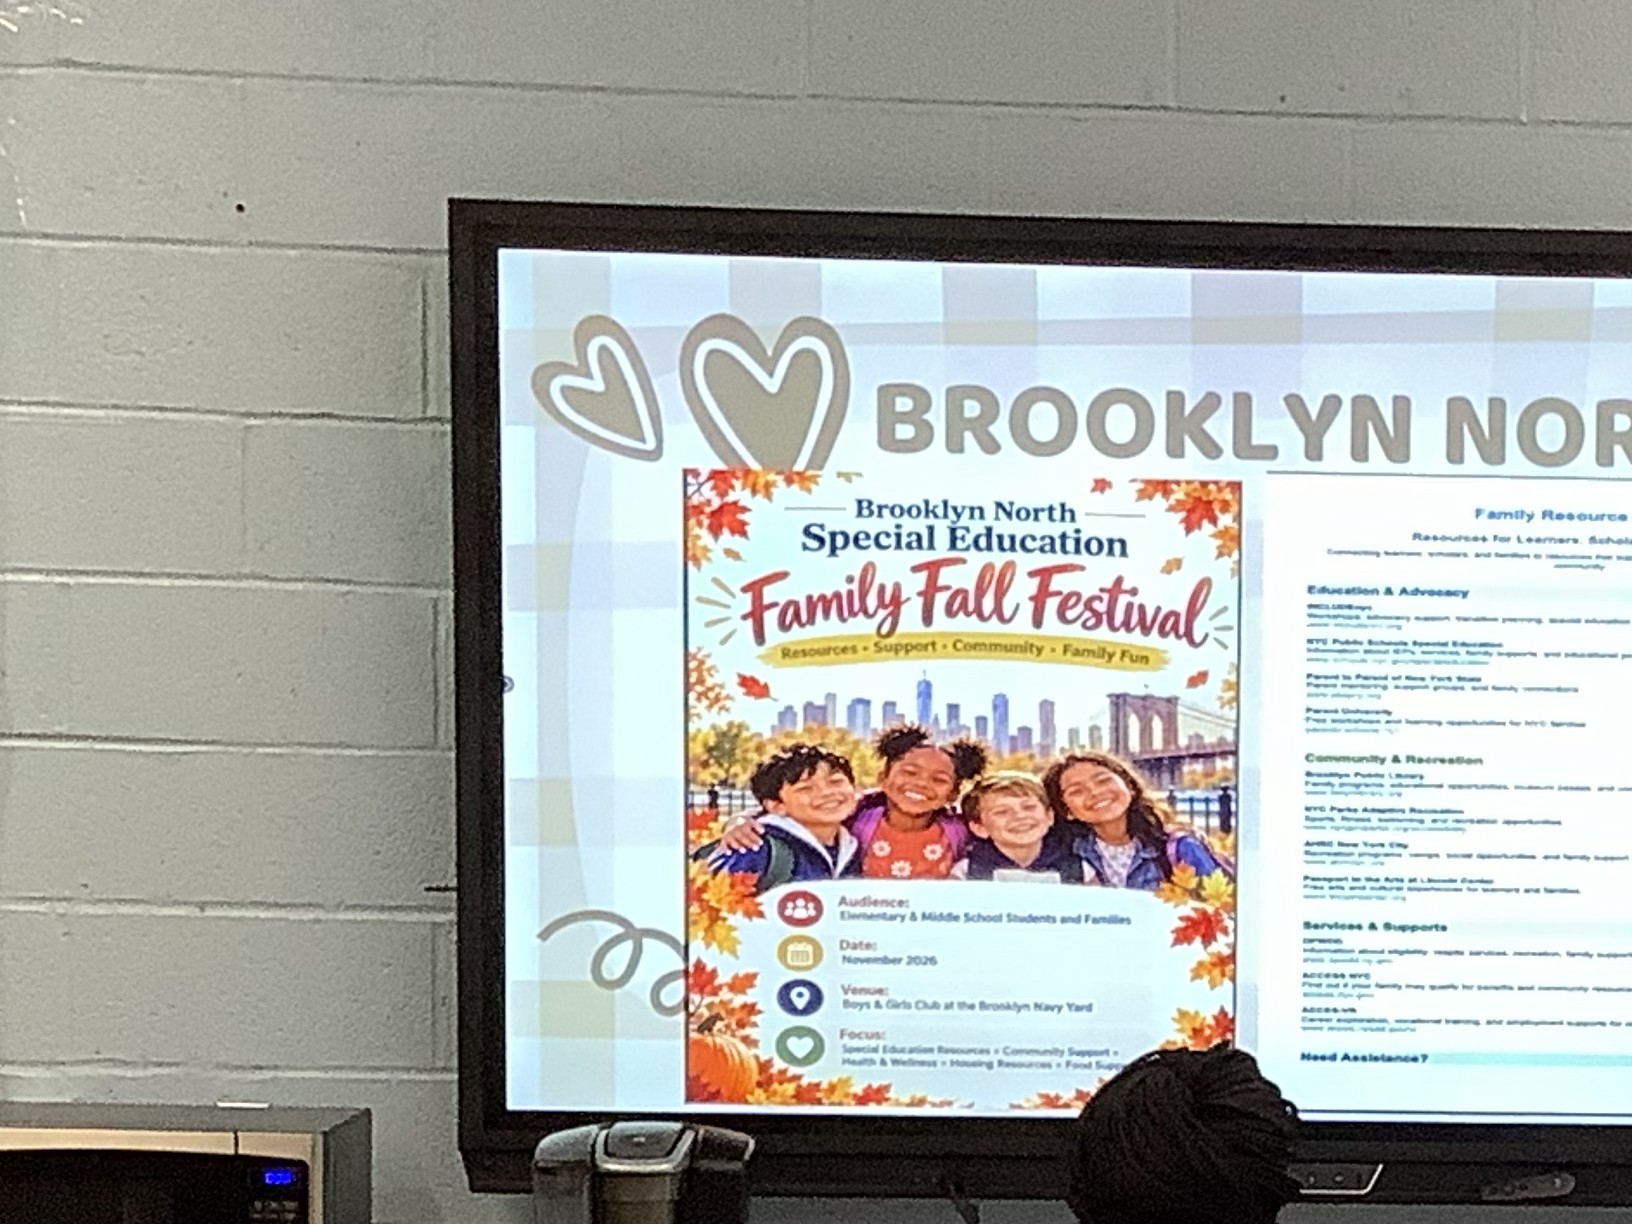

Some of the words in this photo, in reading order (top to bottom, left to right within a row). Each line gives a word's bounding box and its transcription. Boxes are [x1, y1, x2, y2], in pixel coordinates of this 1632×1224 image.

[877, 382, 1411, 464] BROOKLYN
[854, 499, 987, 525] Brooklyn
[993, 501, 1077, 524] North
[1475, 508, 1535, 523] Family
[1541, 510, 1628, 522] Resource
[801, 523, 936, 558] Special
[947, 525, 1129, 559] Education
[1307, 584, 1380, 596] Education
[1383, 585, 1394, 597] &
[1399, 587, 1469, 598] Advocacy
[739, 560, 909, 646] Family
[909, 557, 1020, 628] Fall
[1027, 562, 1214, 649] Festival
[781, 643, 858, 661] Resources
[873, 640, 937, 656] Support
[952, 639, 1044, 658] Community
[1062, 644, 1116, 664] Family
[1119, 648, 1150, 666] Fun
[1305, 753, 1386, 764] Community
[1391, 753, 1401, 765] &
[1405, 755, 1483, 765] Recreation
[838, 895, 910, 909] Audience:
[840, 911, 907, 923] Elementary
[909, 911, 918, 922] &
[921, 912, 961, 922] Middle
[964, 912, 1003, 923] School
[1006, 912, 1057, 924] Students
[1060, 913, 1082, 924] and
[1085, 914, 1132, 925] Families
[1303, 920, 1363, 931] Services
[1368, 920, 1378, 932] &
[1383, 922, 1447, 933] Supports
[839, 939, 877, 951] Date:
[842, 955, 903, 965] November
[906, 955, 938, 966] 2026
[841, 984, 889, 996] Venue:
[843, 999, 871, 1011] Boys
[874, 1000, 883, 1010] &
[886, 1000, 912, 1010] Girls
[915, 1000, 941, 1010] Club
[944, 1001, 954, 1010] at
[957, 1000, 976, 1010] the
[979, 1000, 1031, 1014] Brooklyn
[1033, 1002, 1063, 1014] Navy
[1066, 1002, 1093, 1013] Yard
[839, 1028, 886, 1040] Focus:
[1300, 1051, 1338, 1062] Need
[1341, 1052, 1429, 1064] Assistance?
